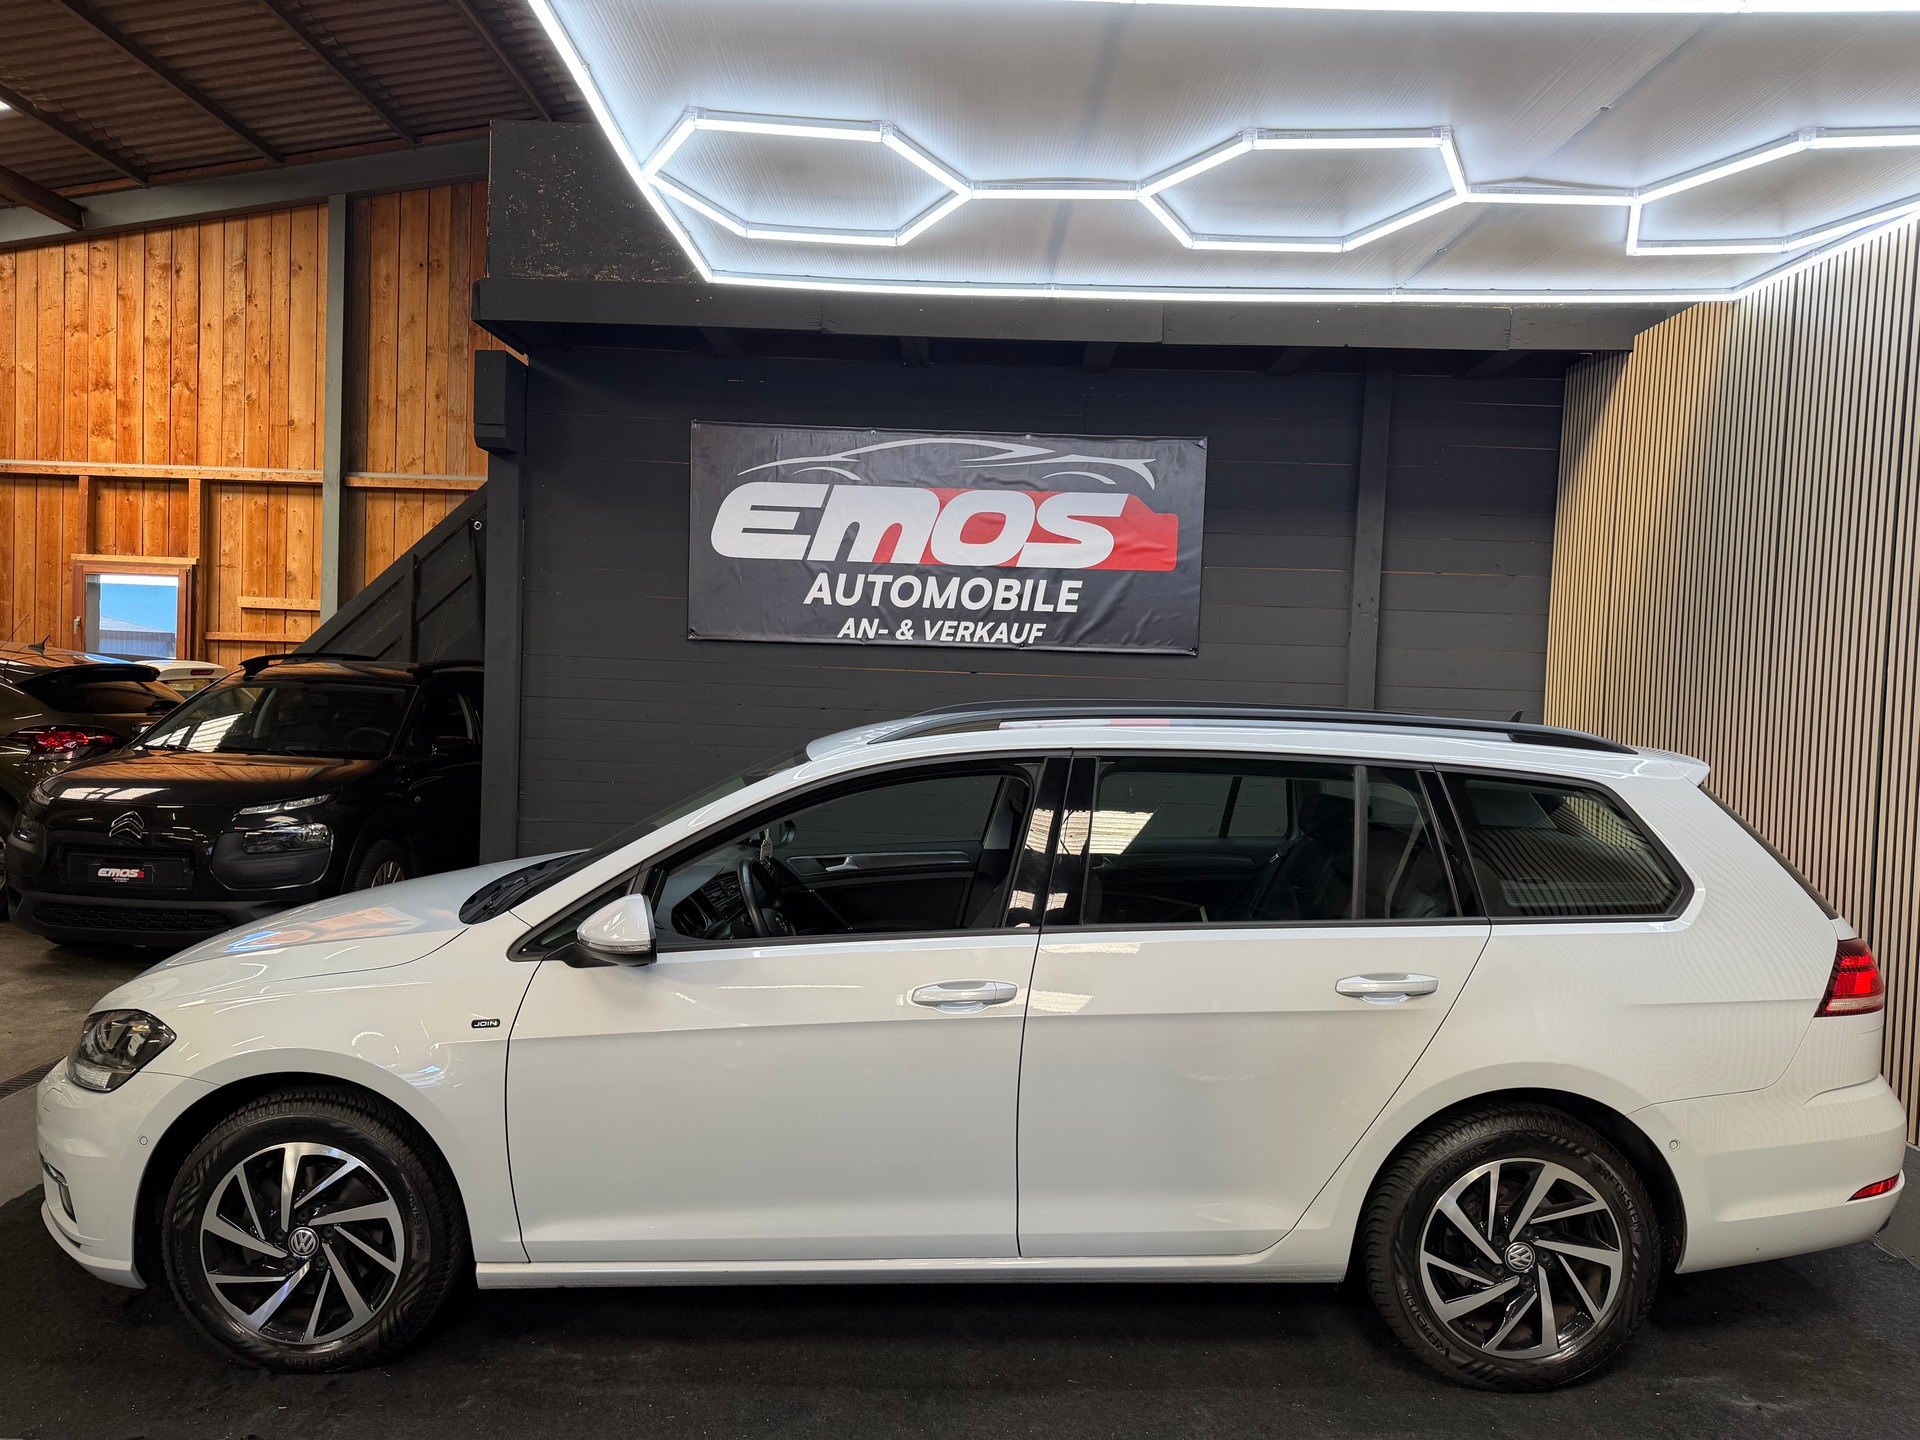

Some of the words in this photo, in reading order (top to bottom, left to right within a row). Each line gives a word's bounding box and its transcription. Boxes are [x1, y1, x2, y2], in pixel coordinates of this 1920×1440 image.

[803, 572, 1083, 613] AUTOMOBILE
[837, 618, 888, 639] AN-
[895, 619, 914, 641] &
[923, 620, 1047, 645] VERKAUF
